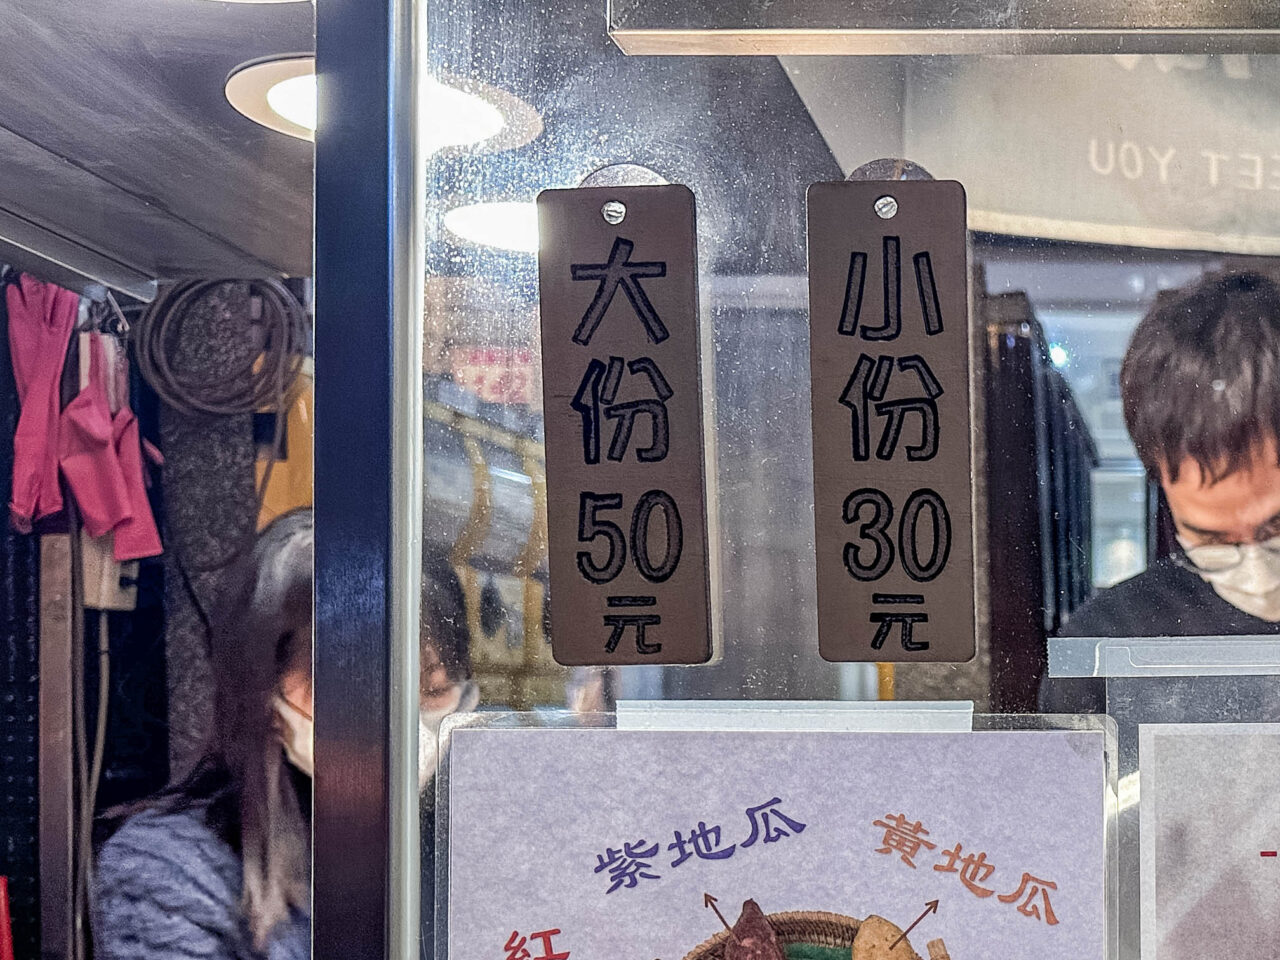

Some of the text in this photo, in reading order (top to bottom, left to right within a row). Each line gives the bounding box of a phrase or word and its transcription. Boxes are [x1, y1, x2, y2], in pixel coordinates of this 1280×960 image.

[593, 797, 807, 895] 紫地瓜
[873, 813, 1061, 926] 黃地瓜
